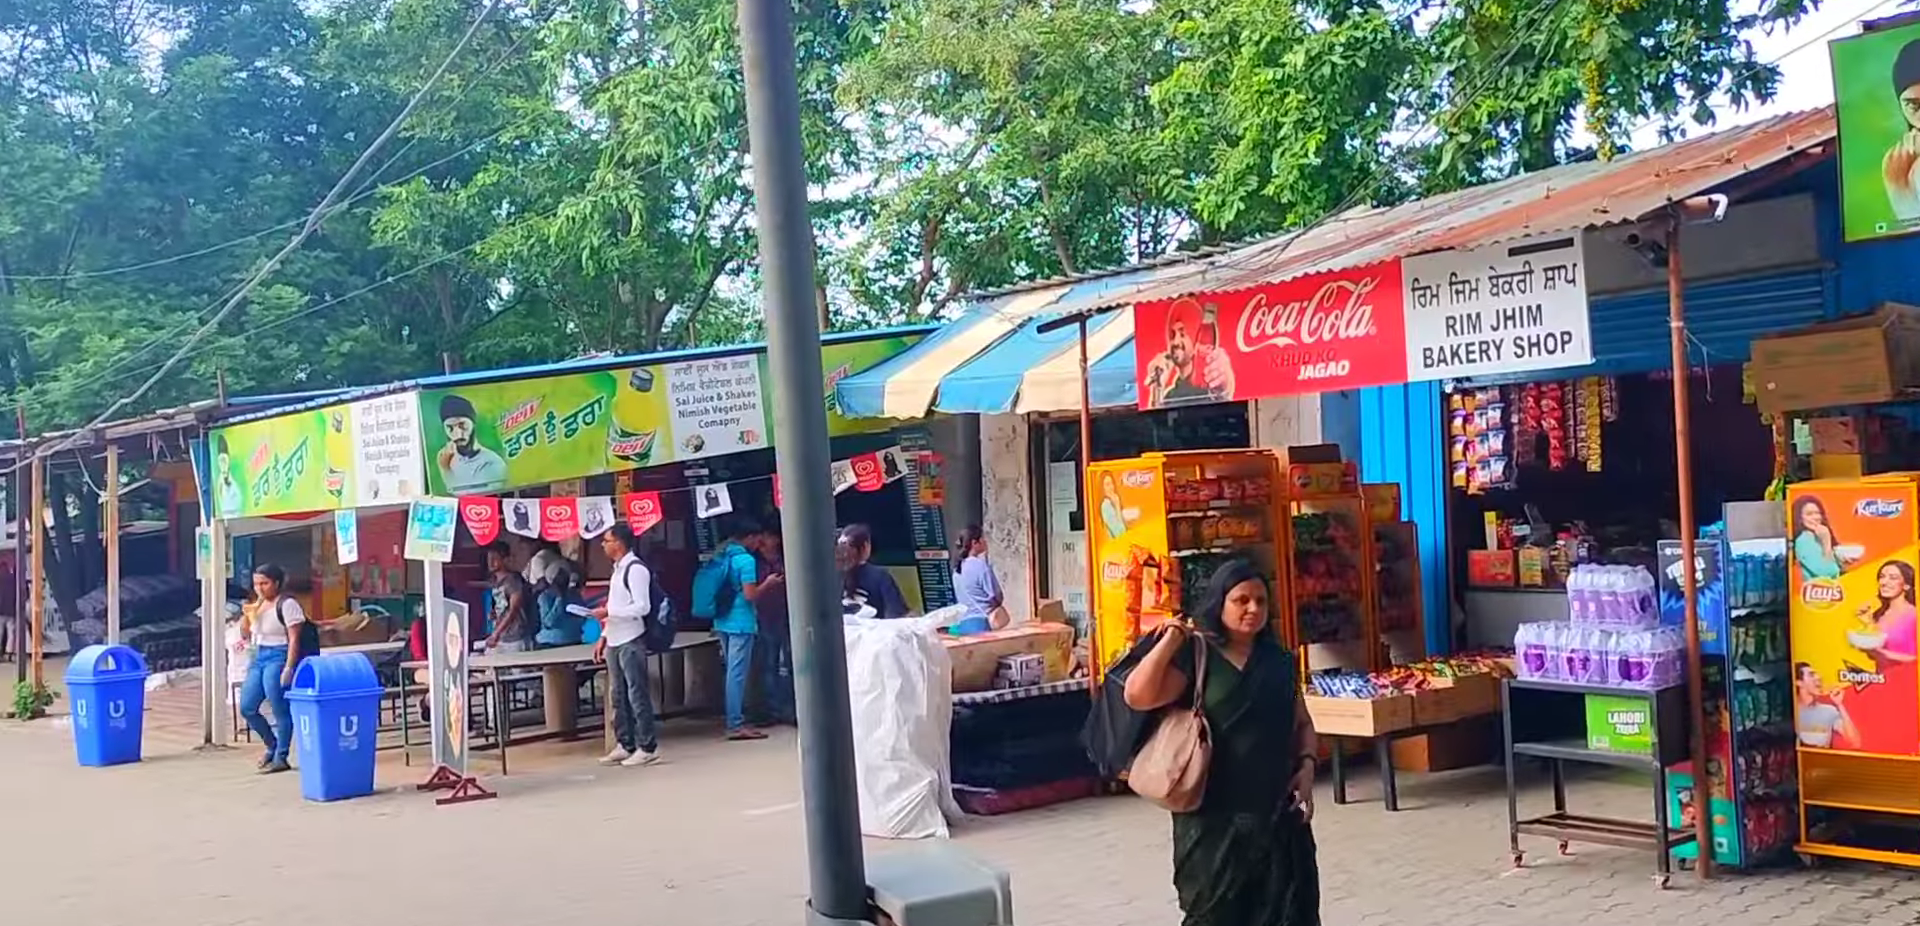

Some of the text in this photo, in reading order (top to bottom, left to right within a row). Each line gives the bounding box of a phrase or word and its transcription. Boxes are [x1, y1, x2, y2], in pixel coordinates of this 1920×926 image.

[1411, 260, 1578, 310] ਰਿਮ ਜਿਮ ਬੇਕਰੀ ਸ਼ਾਪ
[1236, 275, 1381, 353] Coca-Cola
[1445, 303, 1544, 338] RIM JHIM
[1422, 330, 1573, 369] BAKERY SHOP
[1297, 359, 1351, 381] JAGAO
[692, 394, 715, 404] Juice
[716, 393, 723, 401] &
[724, 390, 757, 401] Shakes
[678, 401, 757, 419] Nimish Vegetable
[698, 417, 741, 429] Comapny
[1839, 669, 1886, 684] Doritos
